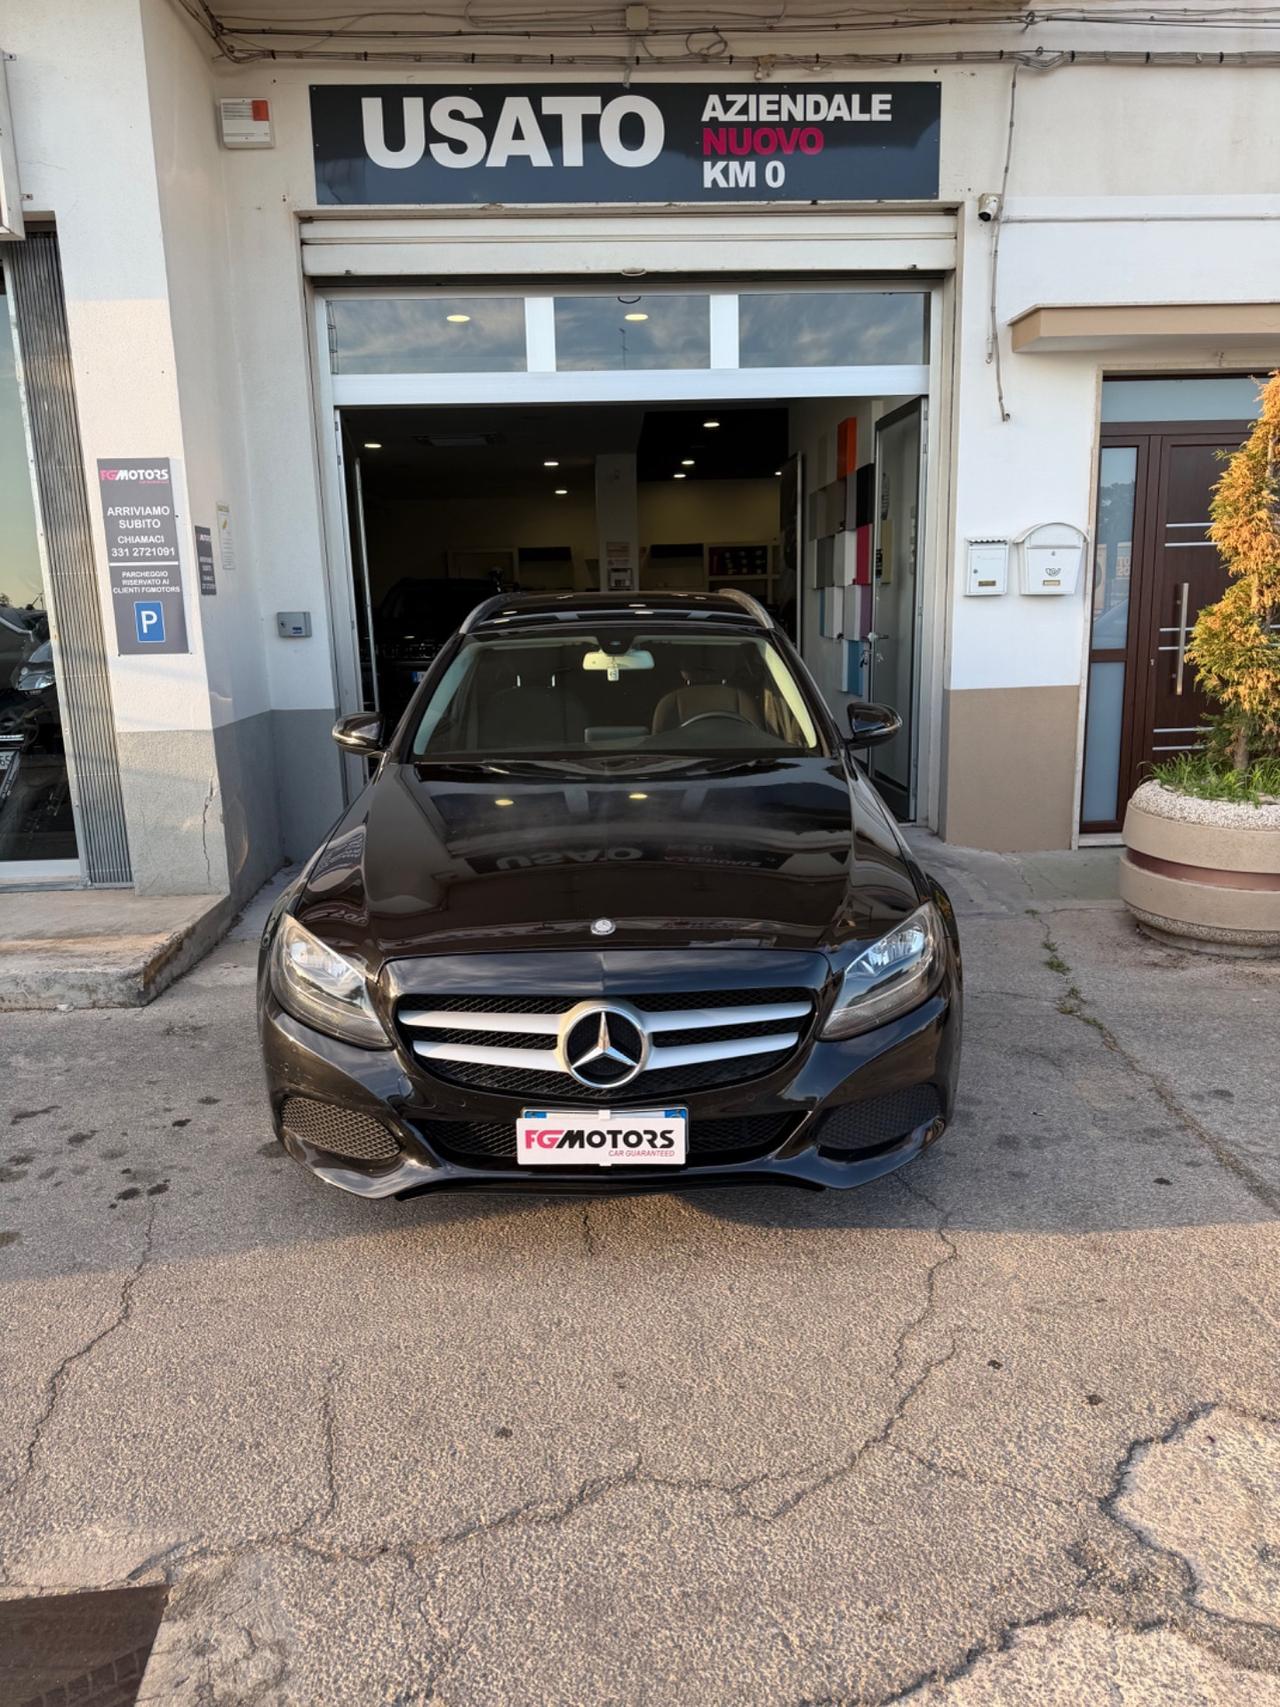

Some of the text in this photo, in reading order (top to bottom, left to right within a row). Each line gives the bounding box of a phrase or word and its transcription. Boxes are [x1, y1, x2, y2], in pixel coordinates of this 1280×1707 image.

[701, 93, 893, 122] AZIENDALE
[361, 95, 666, 170] USATO
[702, 127, 825, 157] NUOVO
[702, 160, 786, 189] KM 0
[100, 469, 169, 481] FGMOTORS
[107, 506, 170, 516] ARRIVIAMO
[119, 519, 161, 529] SUBITO
[117, 535, 165, 544] CHIAMACI
[111, 547, 175, 557] 331 2721091
[121, 570, 168, 578] PARCHEGGIO
[141, 610, 158, 634] P
[525, 1129, 675, 1150] FGMOTORS
